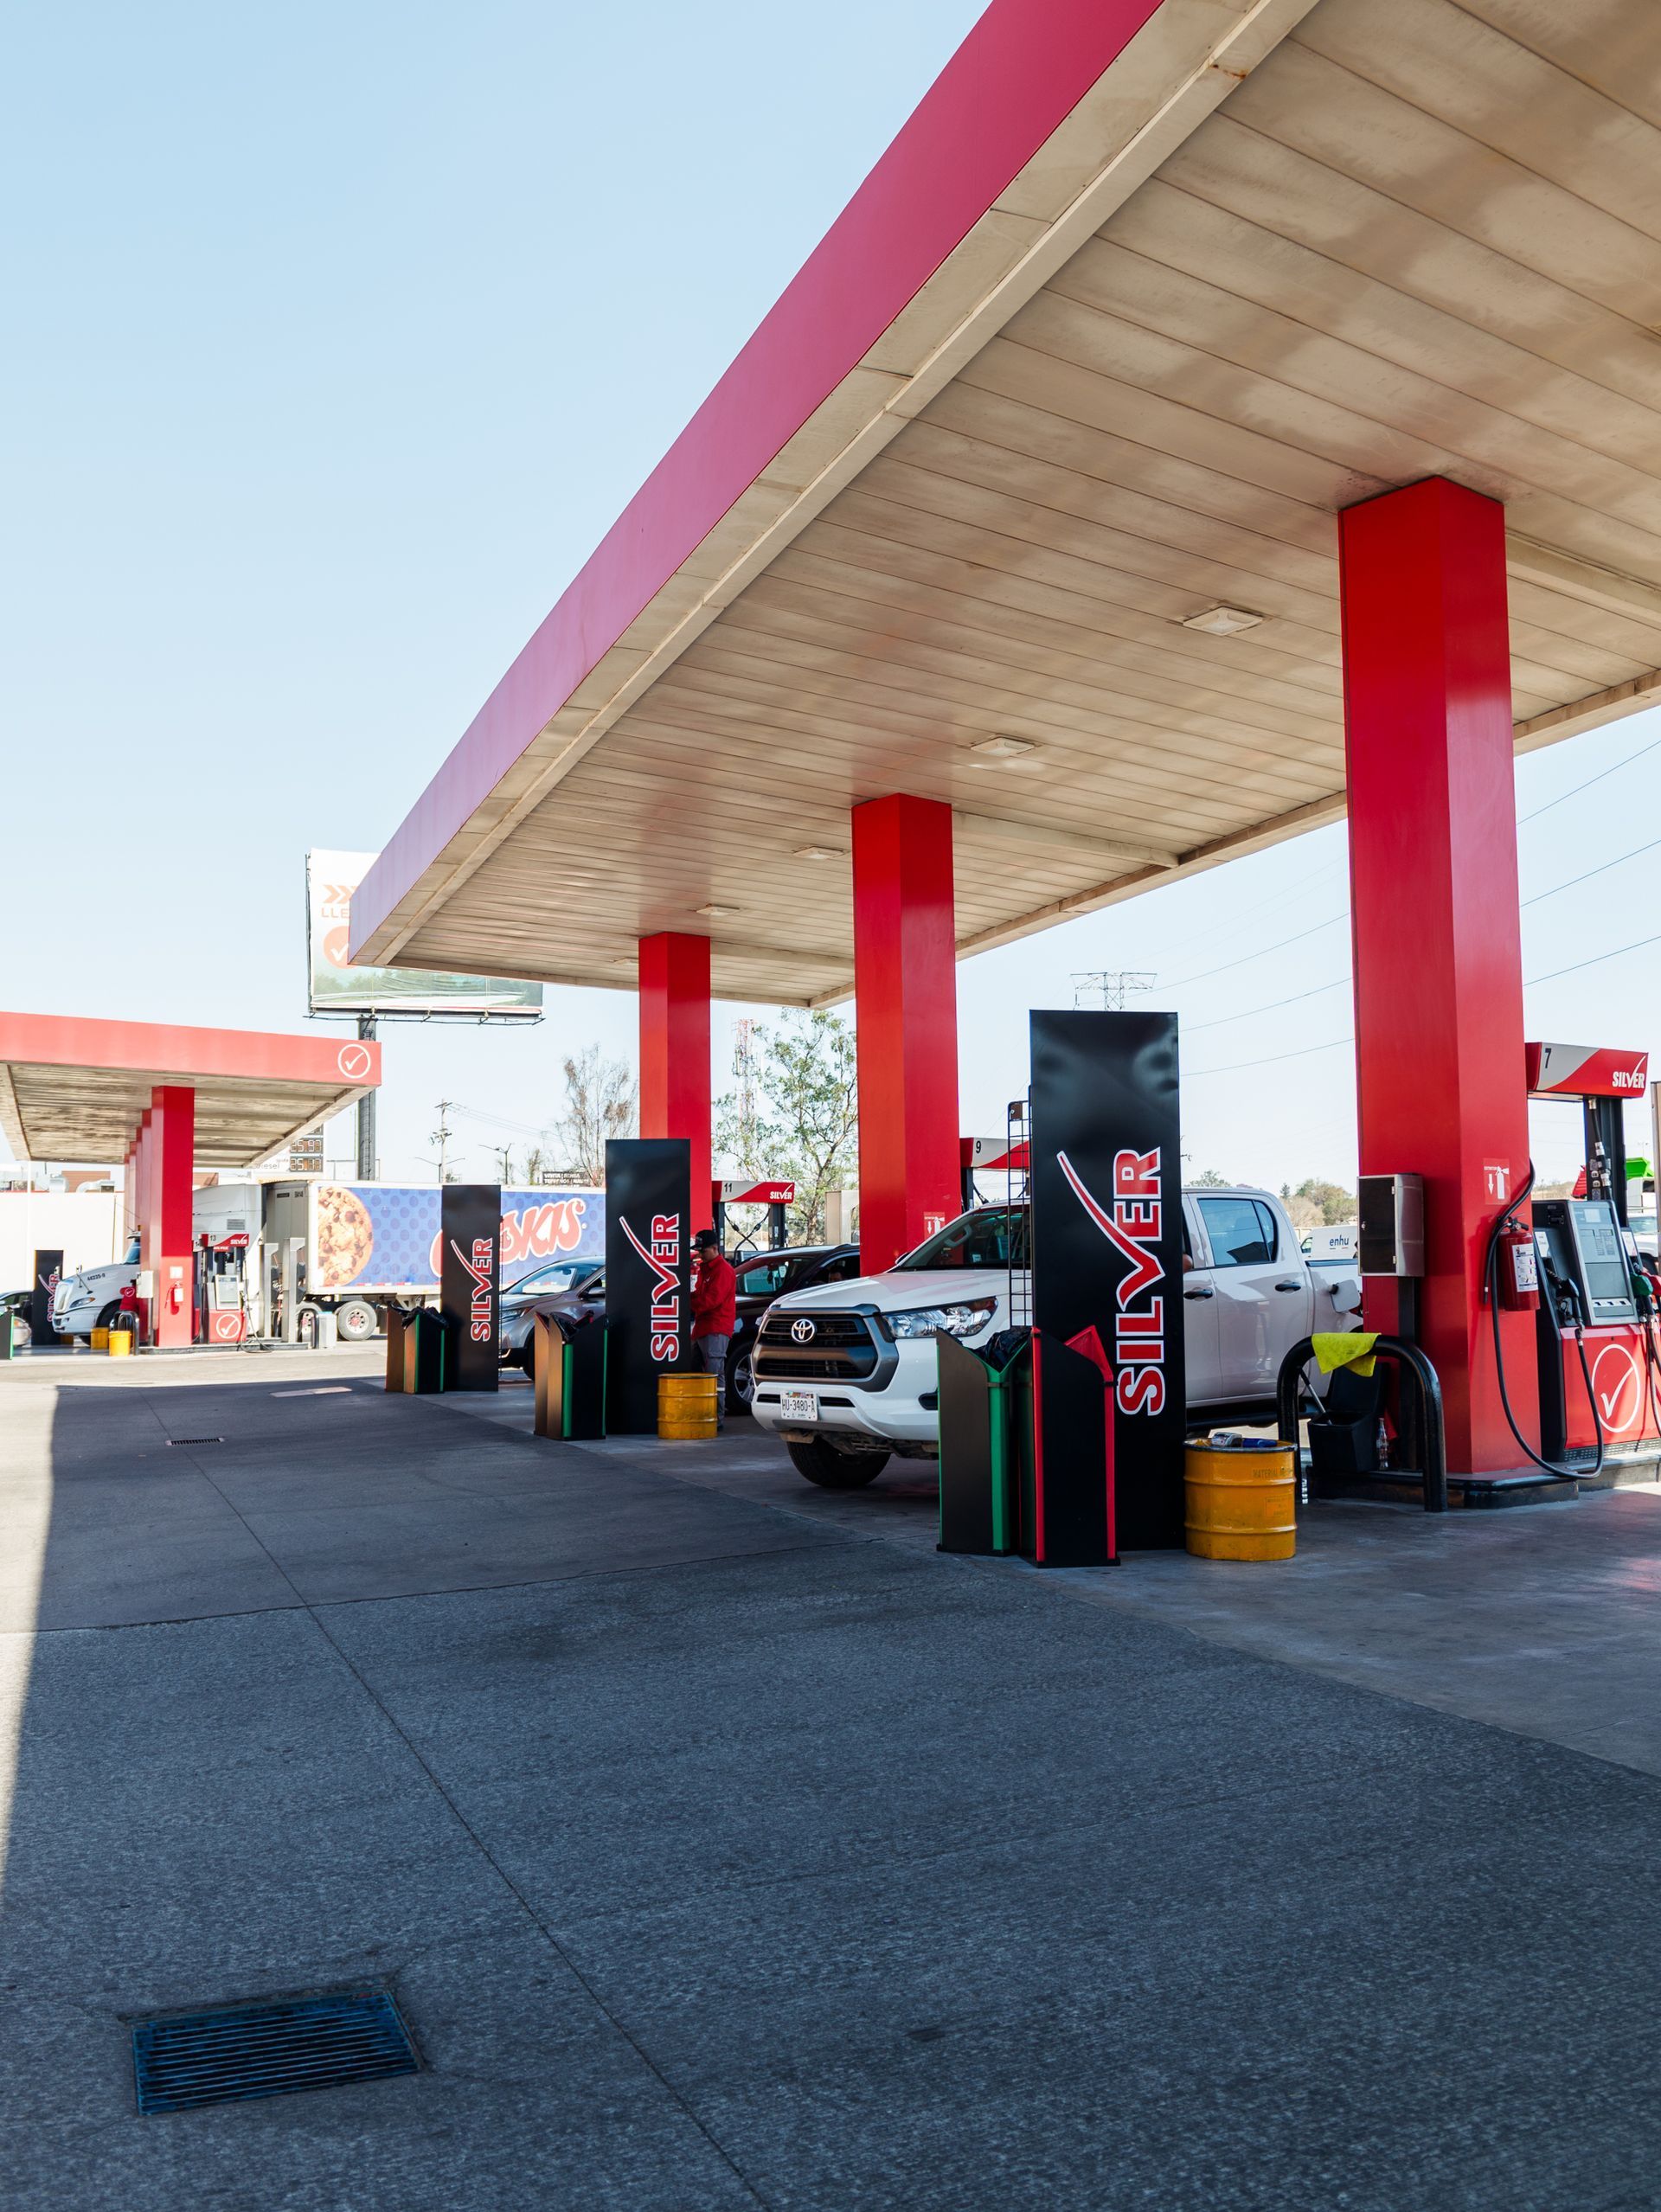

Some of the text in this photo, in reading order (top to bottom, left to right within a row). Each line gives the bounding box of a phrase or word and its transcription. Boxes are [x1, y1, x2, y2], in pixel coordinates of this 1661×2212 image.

[1544, 1048, 1646, 1089] 7 SILVER
[976, 1140, 982, 1154] 9
[724, 1183, 793, 1200] 11 SILVER
[1329, 1234, 1350, 1247] enhu
[450, 1237, 493, 1342] SILVER
[618, 1213, 681, 1362] SILVER
[1056, 1146, 1166, 1416] SILVER
